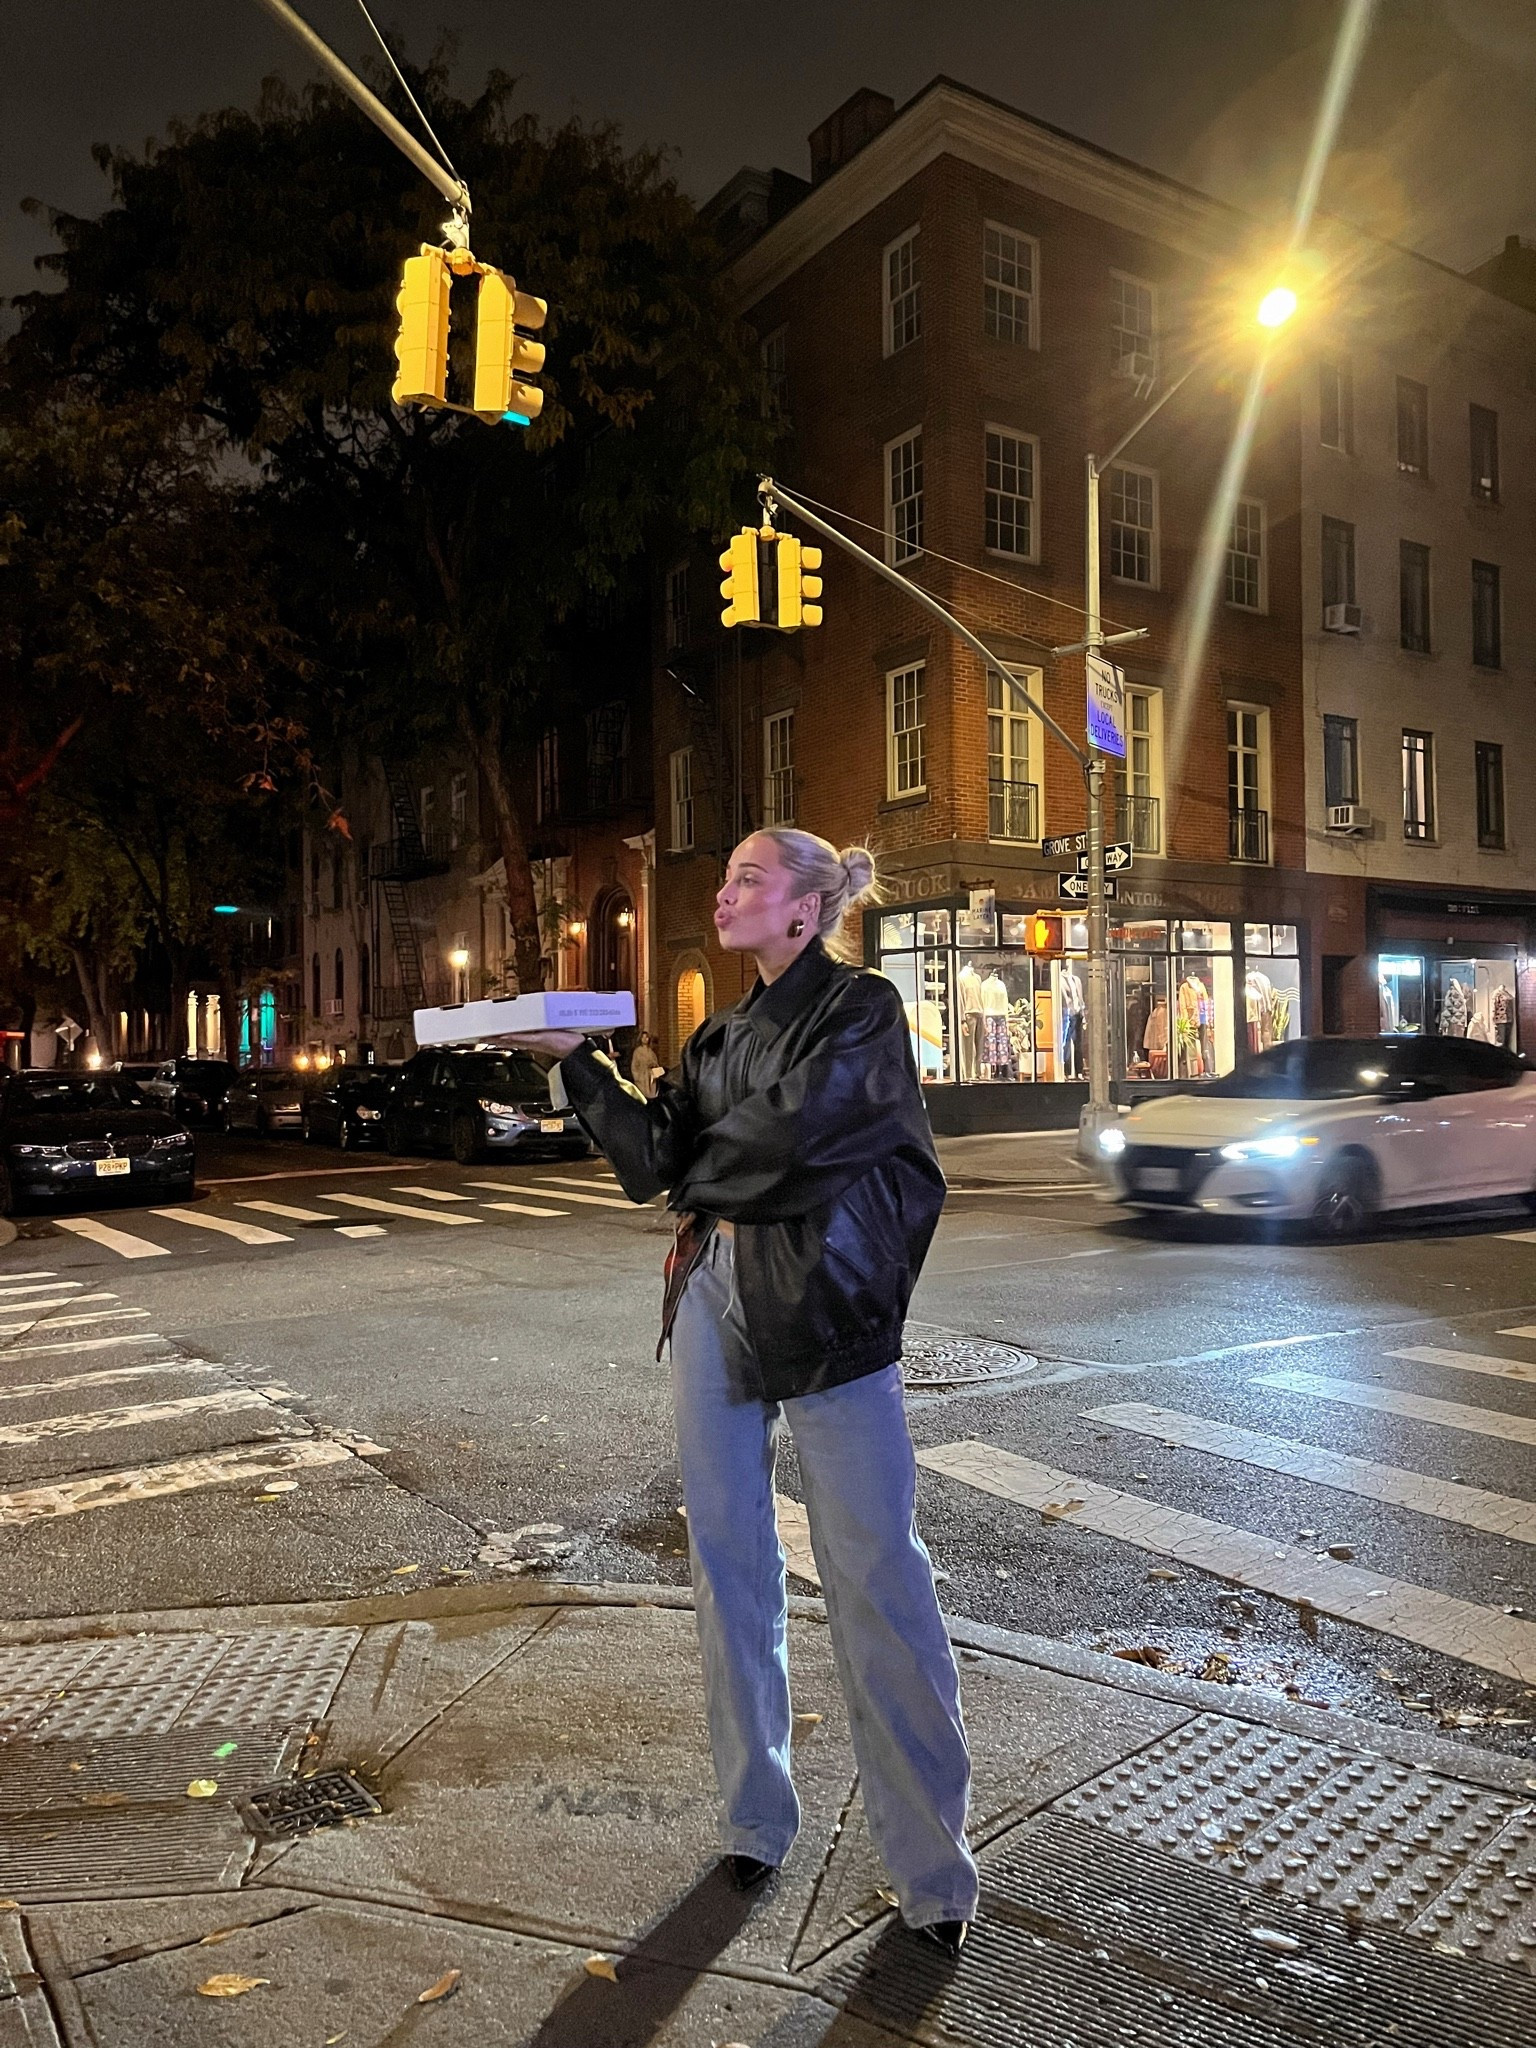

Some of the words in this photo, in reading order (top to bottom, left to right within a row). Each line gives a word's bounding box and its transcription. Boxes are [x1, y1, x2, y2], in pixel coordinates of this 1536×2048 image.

[1101, 669, 1111, 684] NO
[1095, 682, 1118, 703] TRUCKS
[1097, 710, 1117, 729] LOCAL
[1090, 723, 1123, 747] DELIVERIES
[1043, 837, 1071, 856] GROVE
[1075, 834, 1086, 850] ST
[1106, 852, 1123, 864] WAY
[1069, 881, 1088, 892] ONE
